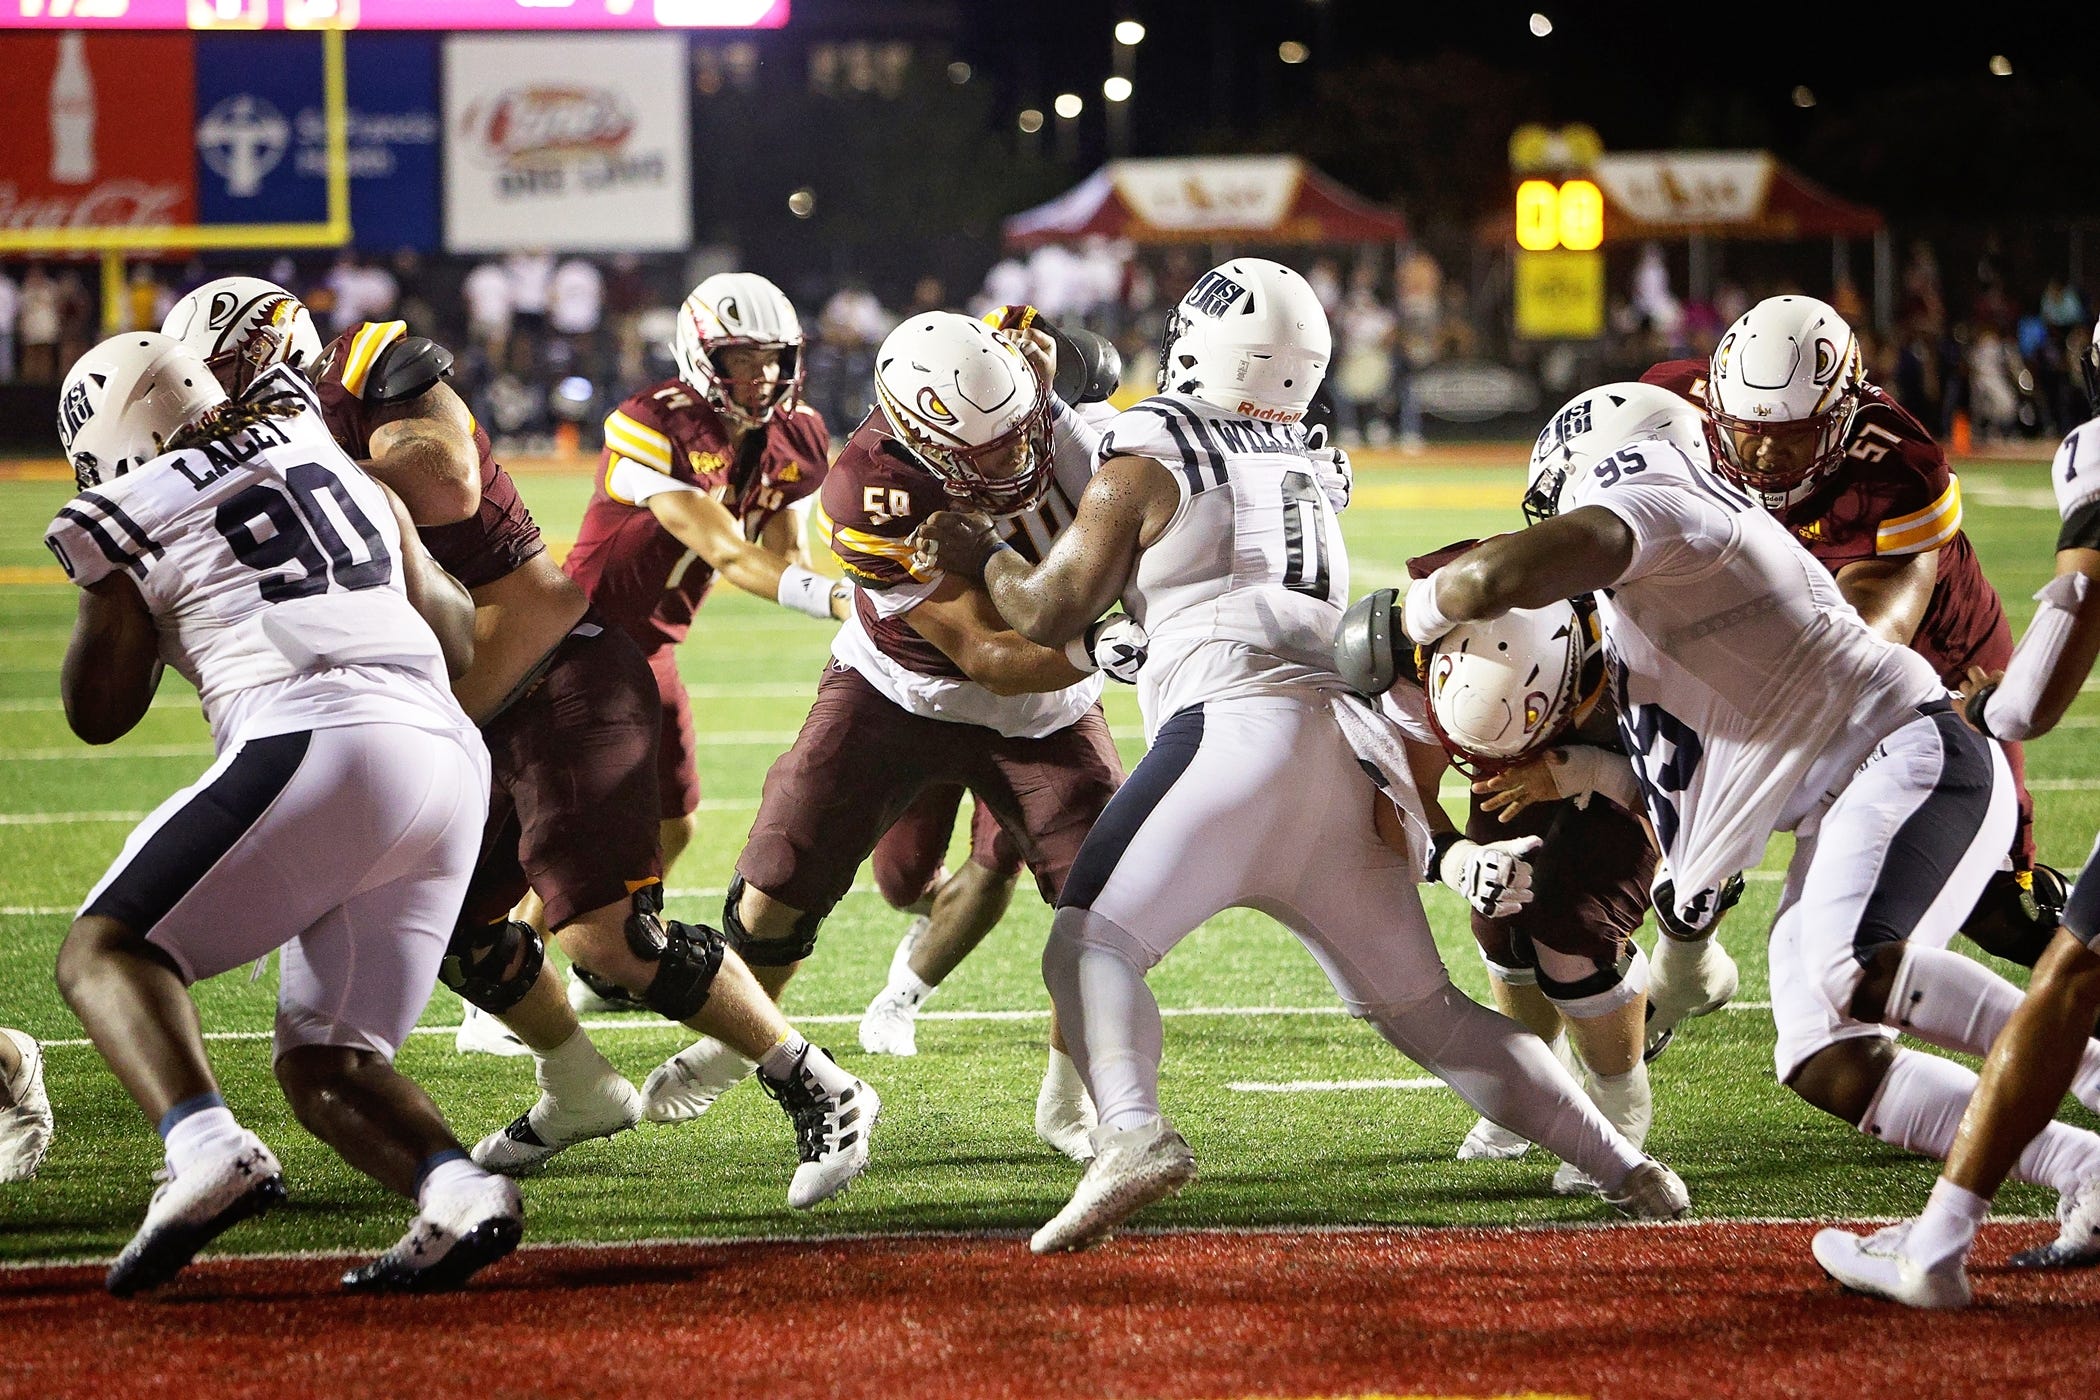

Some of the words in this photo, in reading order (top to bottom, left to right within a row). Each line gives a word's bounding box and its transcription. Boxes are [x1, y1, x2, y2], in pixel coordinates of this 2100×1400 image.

[1187, 272, 1245, 318] JSU
[58, 380, 95, 451] JSU
[1236, 401, 1302, 424] Riddell
[1850, 422, 1902, 463] 57
[2064, 432, 2080, 483] 7
[1593, 445, 1648, 489] 95
[1758, 493, 1784, 502] Rddell
[215, 462, 392, 604] 90
[1280, 470, 1330, 602] 0
